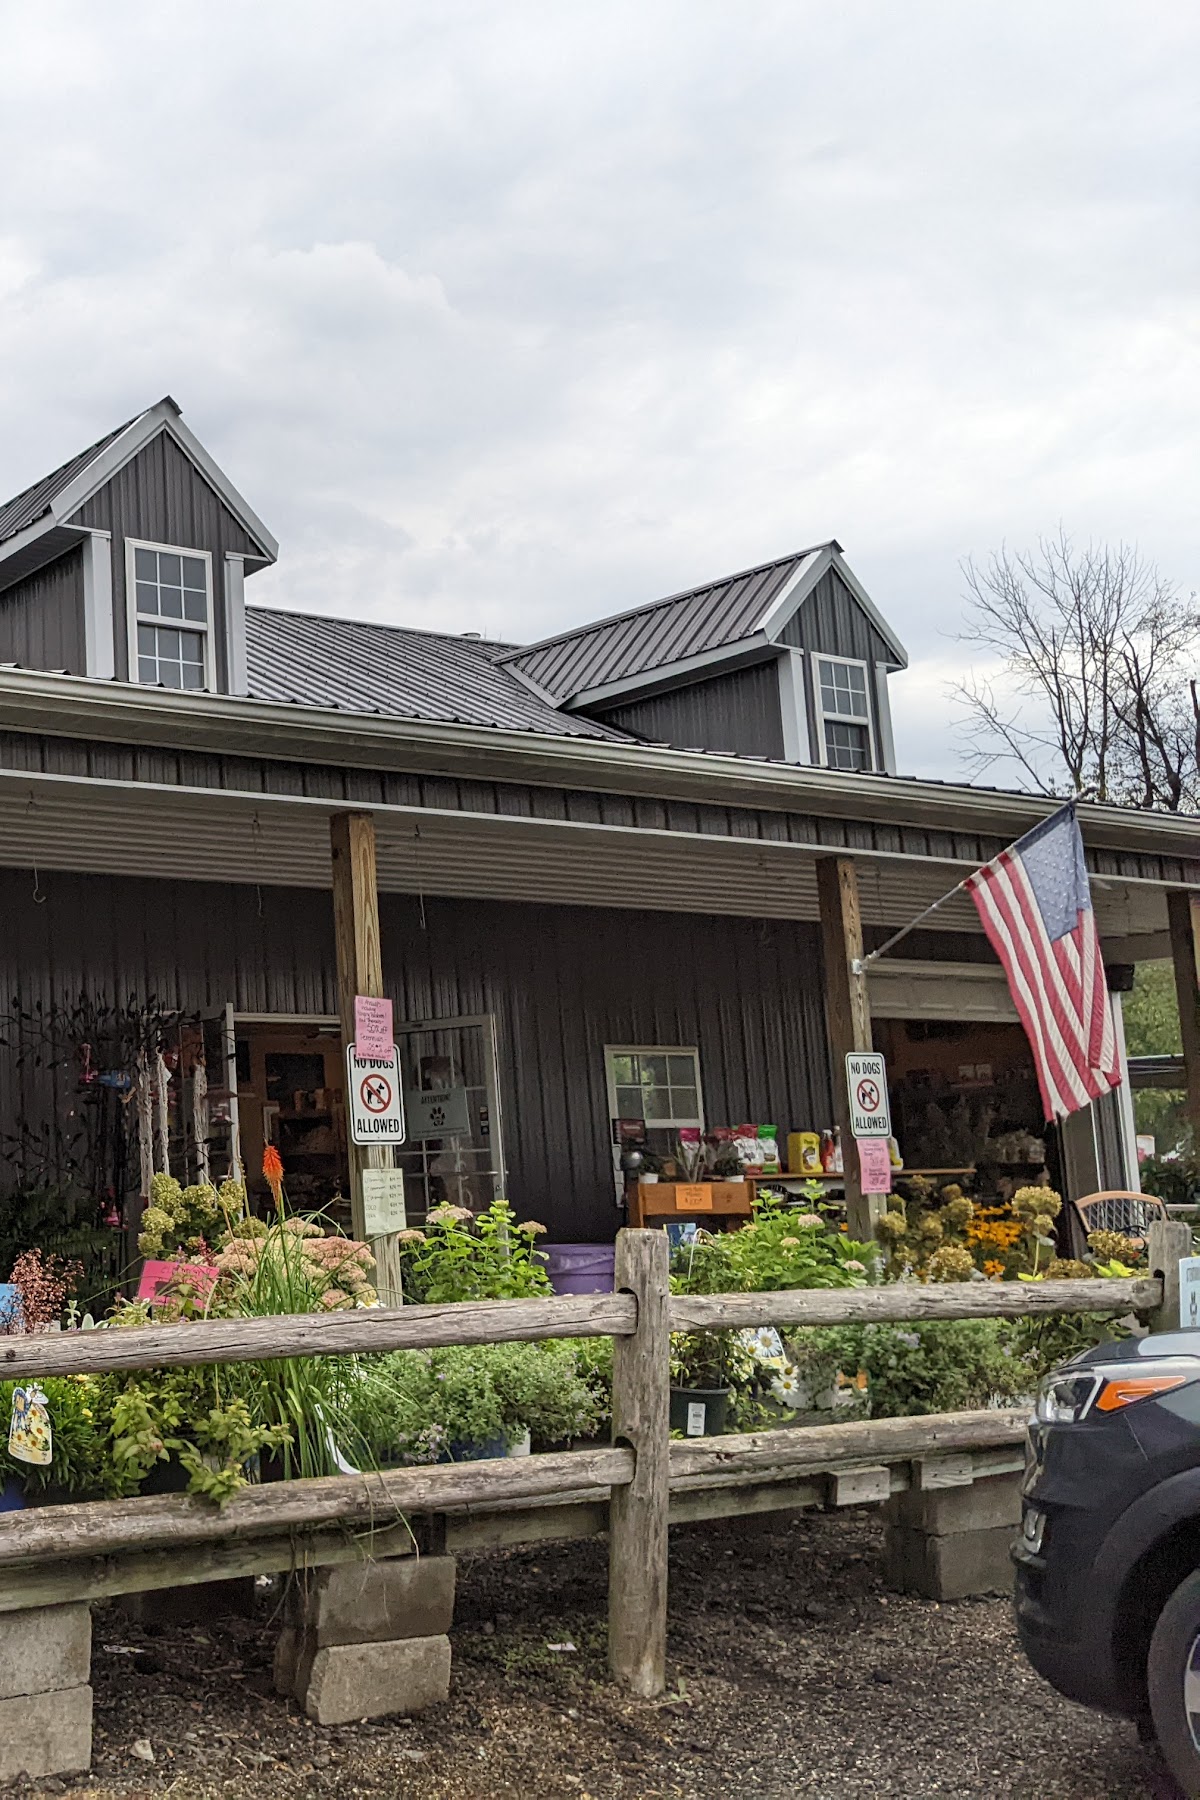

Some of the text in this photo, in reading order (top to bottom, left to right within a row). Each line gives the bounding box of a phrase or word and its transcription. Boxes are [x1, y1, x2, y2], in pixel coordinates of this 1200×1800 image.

[851, 1063, 880, 1074] NO DOGS
[357, 1118, 400, 1133] ALLOWED
[856, 1117, 887, 1129] ALLOWED
